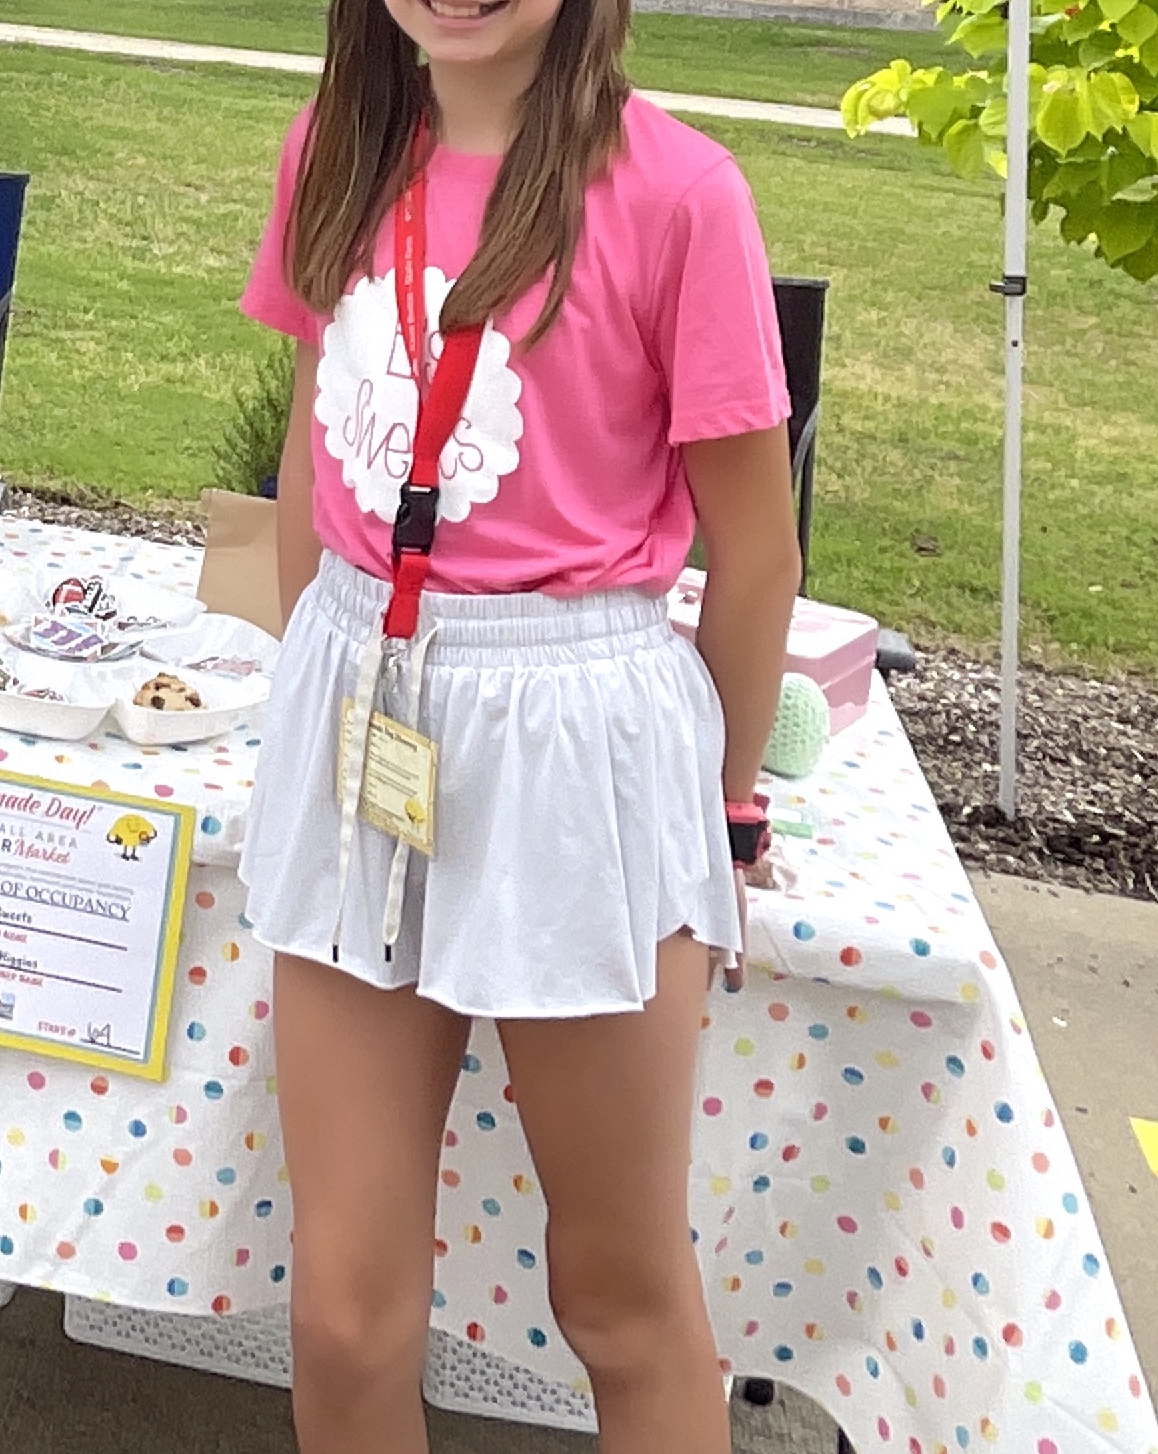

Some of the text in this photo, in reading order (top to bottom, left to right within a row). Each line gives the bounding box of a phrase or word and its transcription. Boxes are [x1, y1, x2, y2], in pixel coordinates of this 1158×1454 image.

[45, 796, 97, 830] Day!
[13, 838, 70, 864] Market
[35, 830, 78, 849] AREA
[0, 880, 24, 896] OF
[26, 884, 132, 922] OCCUPANCY
